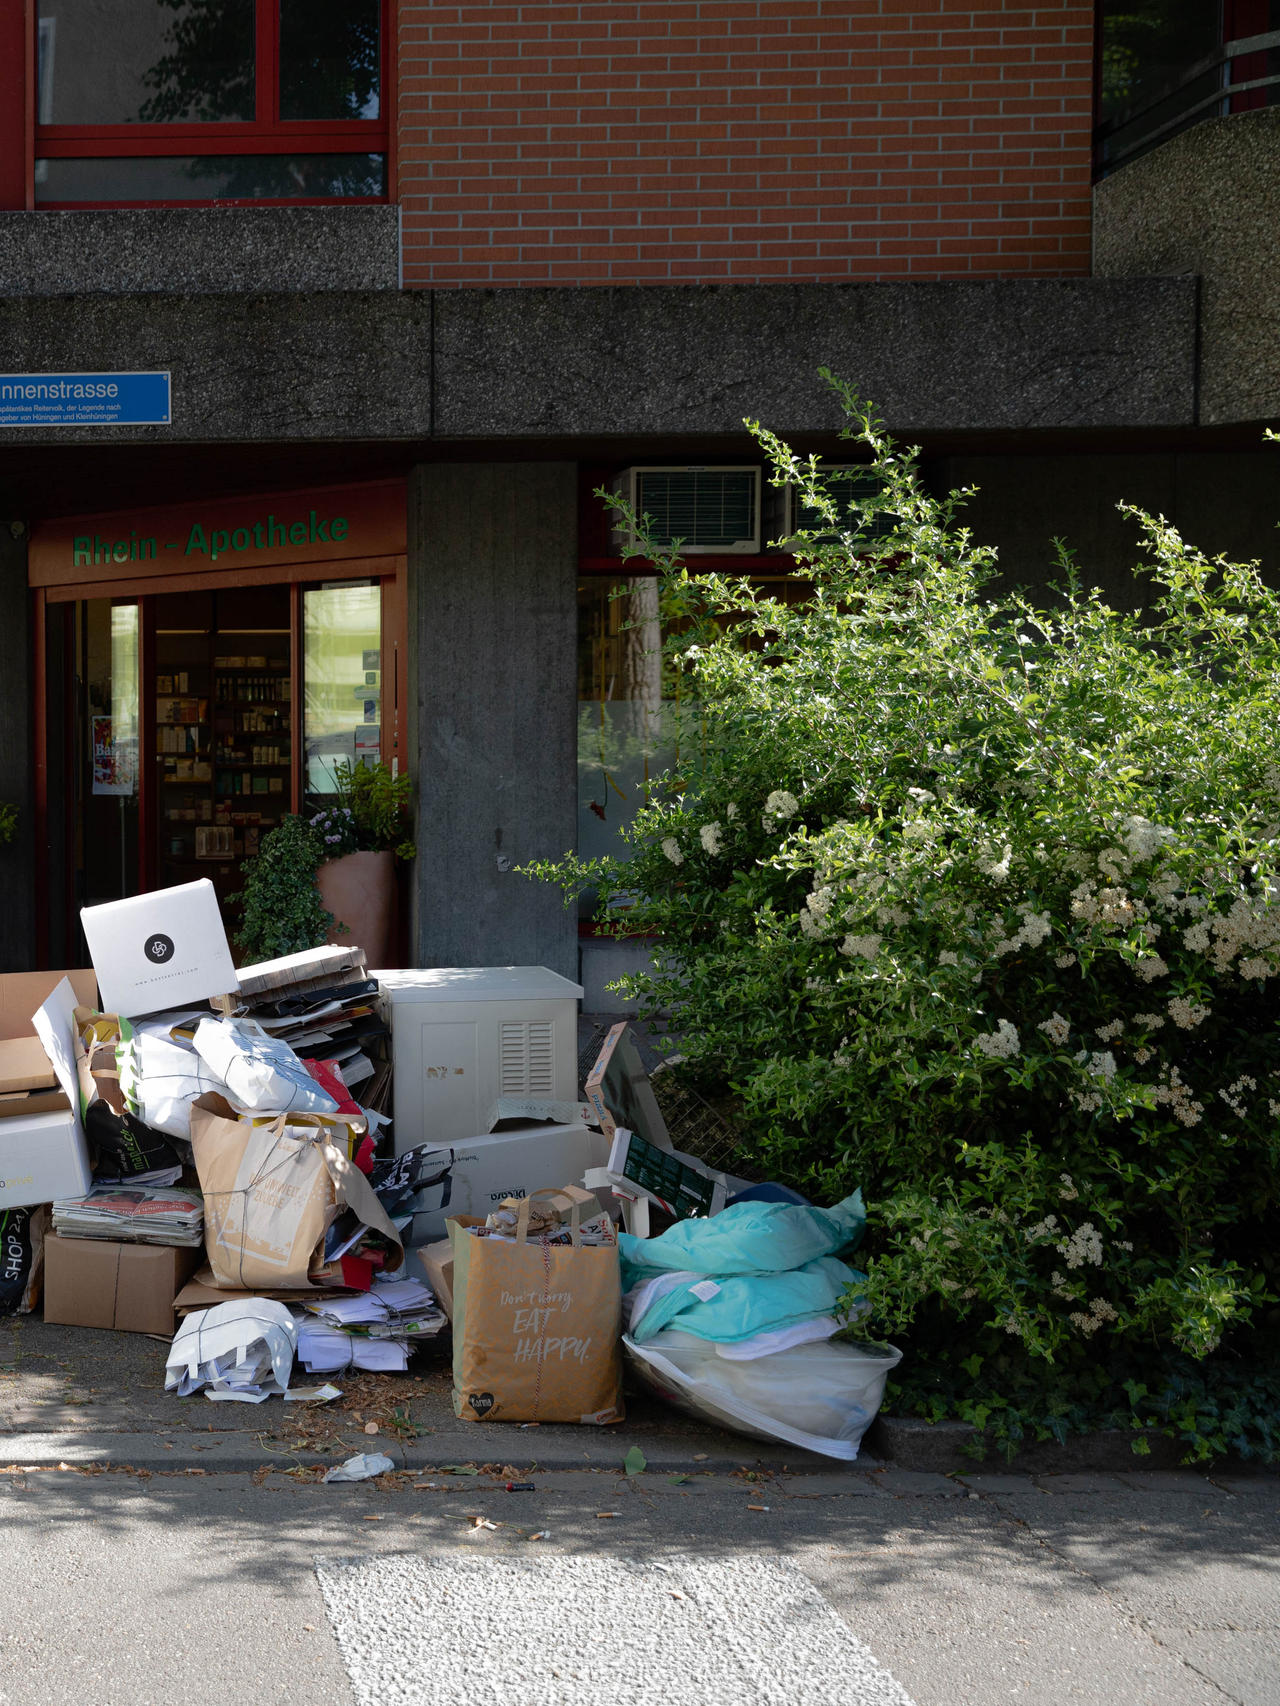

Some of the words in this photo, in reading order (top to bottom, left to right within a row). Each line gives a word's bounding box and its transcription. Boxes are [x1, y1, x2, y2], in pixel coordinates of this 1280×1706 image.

[33, 413, 61, 422] Hüningen
[76, 412, 118, 421] Kleinhüningen
[67, 404, 76, 412] der
[78, 404, 105, 413] Legende
[107, 403, 122, 411] nach
[72, 530, 157, 567] Rhein
[184, 510, 350, 561] Apotheke
[5, 1235, 23, 1280] SHOP
[500, 1291, 537, 1306] Don't
[512, 1307, 558, 1334] EAT
[513, 1336, 592, 1366] HAPPY.
